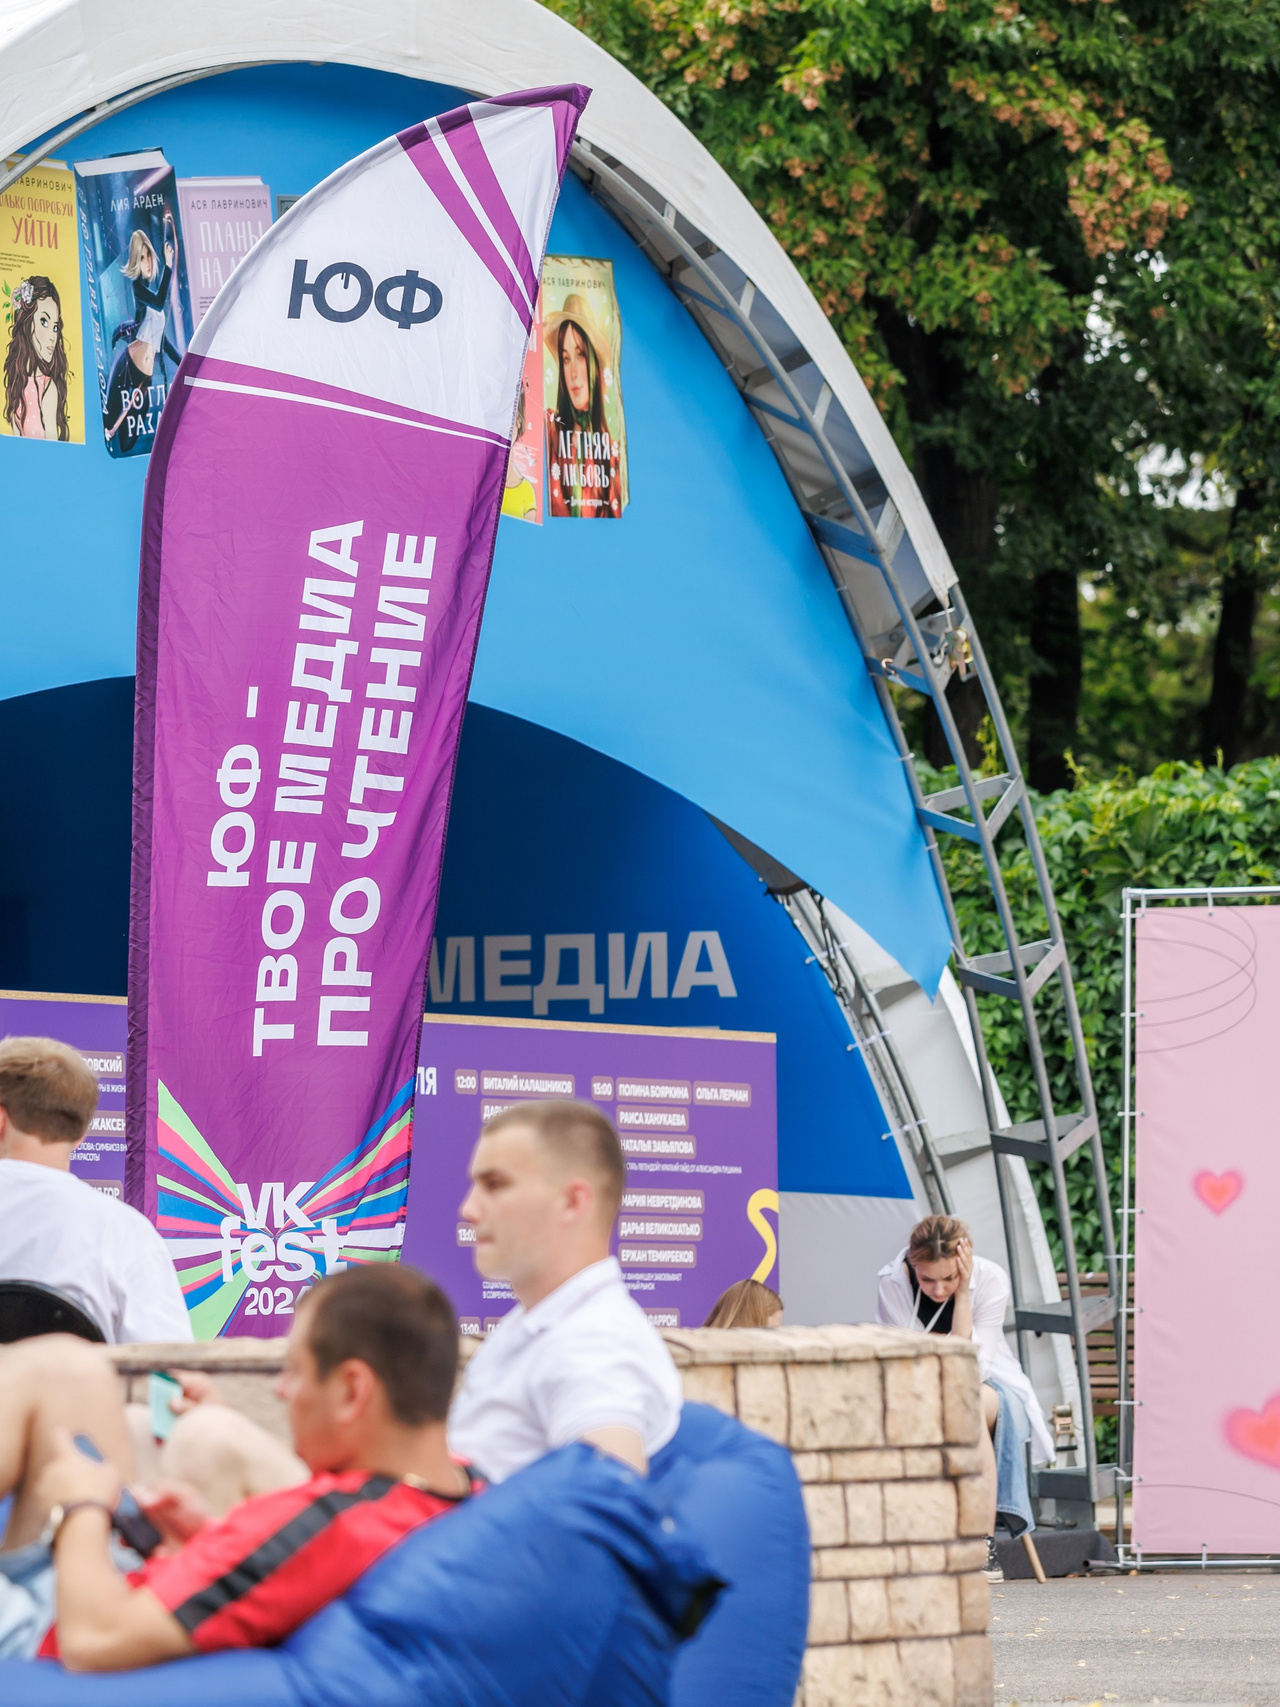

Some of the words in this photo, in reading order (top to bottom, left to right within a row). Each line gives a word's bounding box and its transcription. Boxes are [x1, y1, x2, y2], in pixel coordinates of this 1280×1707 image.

[27, 197, 73, 217] ПОПРОБУЙ
[110, 198, 130, 212] ЛИЯ
[133, 193, 164, 209] АРДЕН
[191, 199, 208, 210] АСЯ
[211, 199, 268, 210] ЛАВРИНОВИЧ
[12, 213, 58, 250] УЙТИ
[287, 259, 443, 330] ЮФ
[121, 387, 144, 411] ВО
[147, 383, 172, 408] ГЛ
[559, 430, 610, 460] ЛЕТНЯЯ
[563, 463, 609, 488] ЛЮБОВЬ
[274, 520, 364, 815] МЕДИА
[340, 532, 437, 859] ЧТЕНИЕ
[207, 744, 261, 887] ЮФ
[246, 686, 259, 718] -
[253, 840, 317, 1057] ТВОЕ
[317, 876, 381, 1047] ПРО
[428, 931, 738, 1015] МЕДИА
[456, 1075, 477, 1090] 12:00
[483, 1075, 519, 1091] ВИТАЛИЙ
[520, 1079, 572, 1094] КАЛАШНИКОВ
[593, 1083, 612, 1096] 15:00
[619, 1084, 649, 1098] ПОЛИНА
[650, 1085, 689, 1100] БОЯРКИНА
[696, 1087, 719, 1101] ОЛЬГА
[720, 1089, 748, 1103] ЛЕРМАН
[620, 1111, 643, 1125] РАИСА
[644, 1112, 686, 1127] ХАНУКАЕВА
[620, 1139, 652, 1152] НАТАЛЬЯ
[653, 1140, 694, 1155] ЗАВЬЯЛОВА
[235, 1182, 317, 1229] VK
[622, 1194, 646, 1208] МАРИЯ
[647, 1195, 702, 1210] НЕВРЕТДИНОВА
[620, 1221, 645, 1236] ДАРЬЯ
[646, 1223, 700, 1236] ВЕЛИКОХАТЬКО
[220, 1215, 348, 1282] fest
[621, 1249, 647, 1262] ЕРЖАН
[648, 1250, 694, 1263] ТЕМИРБЕКОВ
[460, 1323, 480, 1336] 13:00
